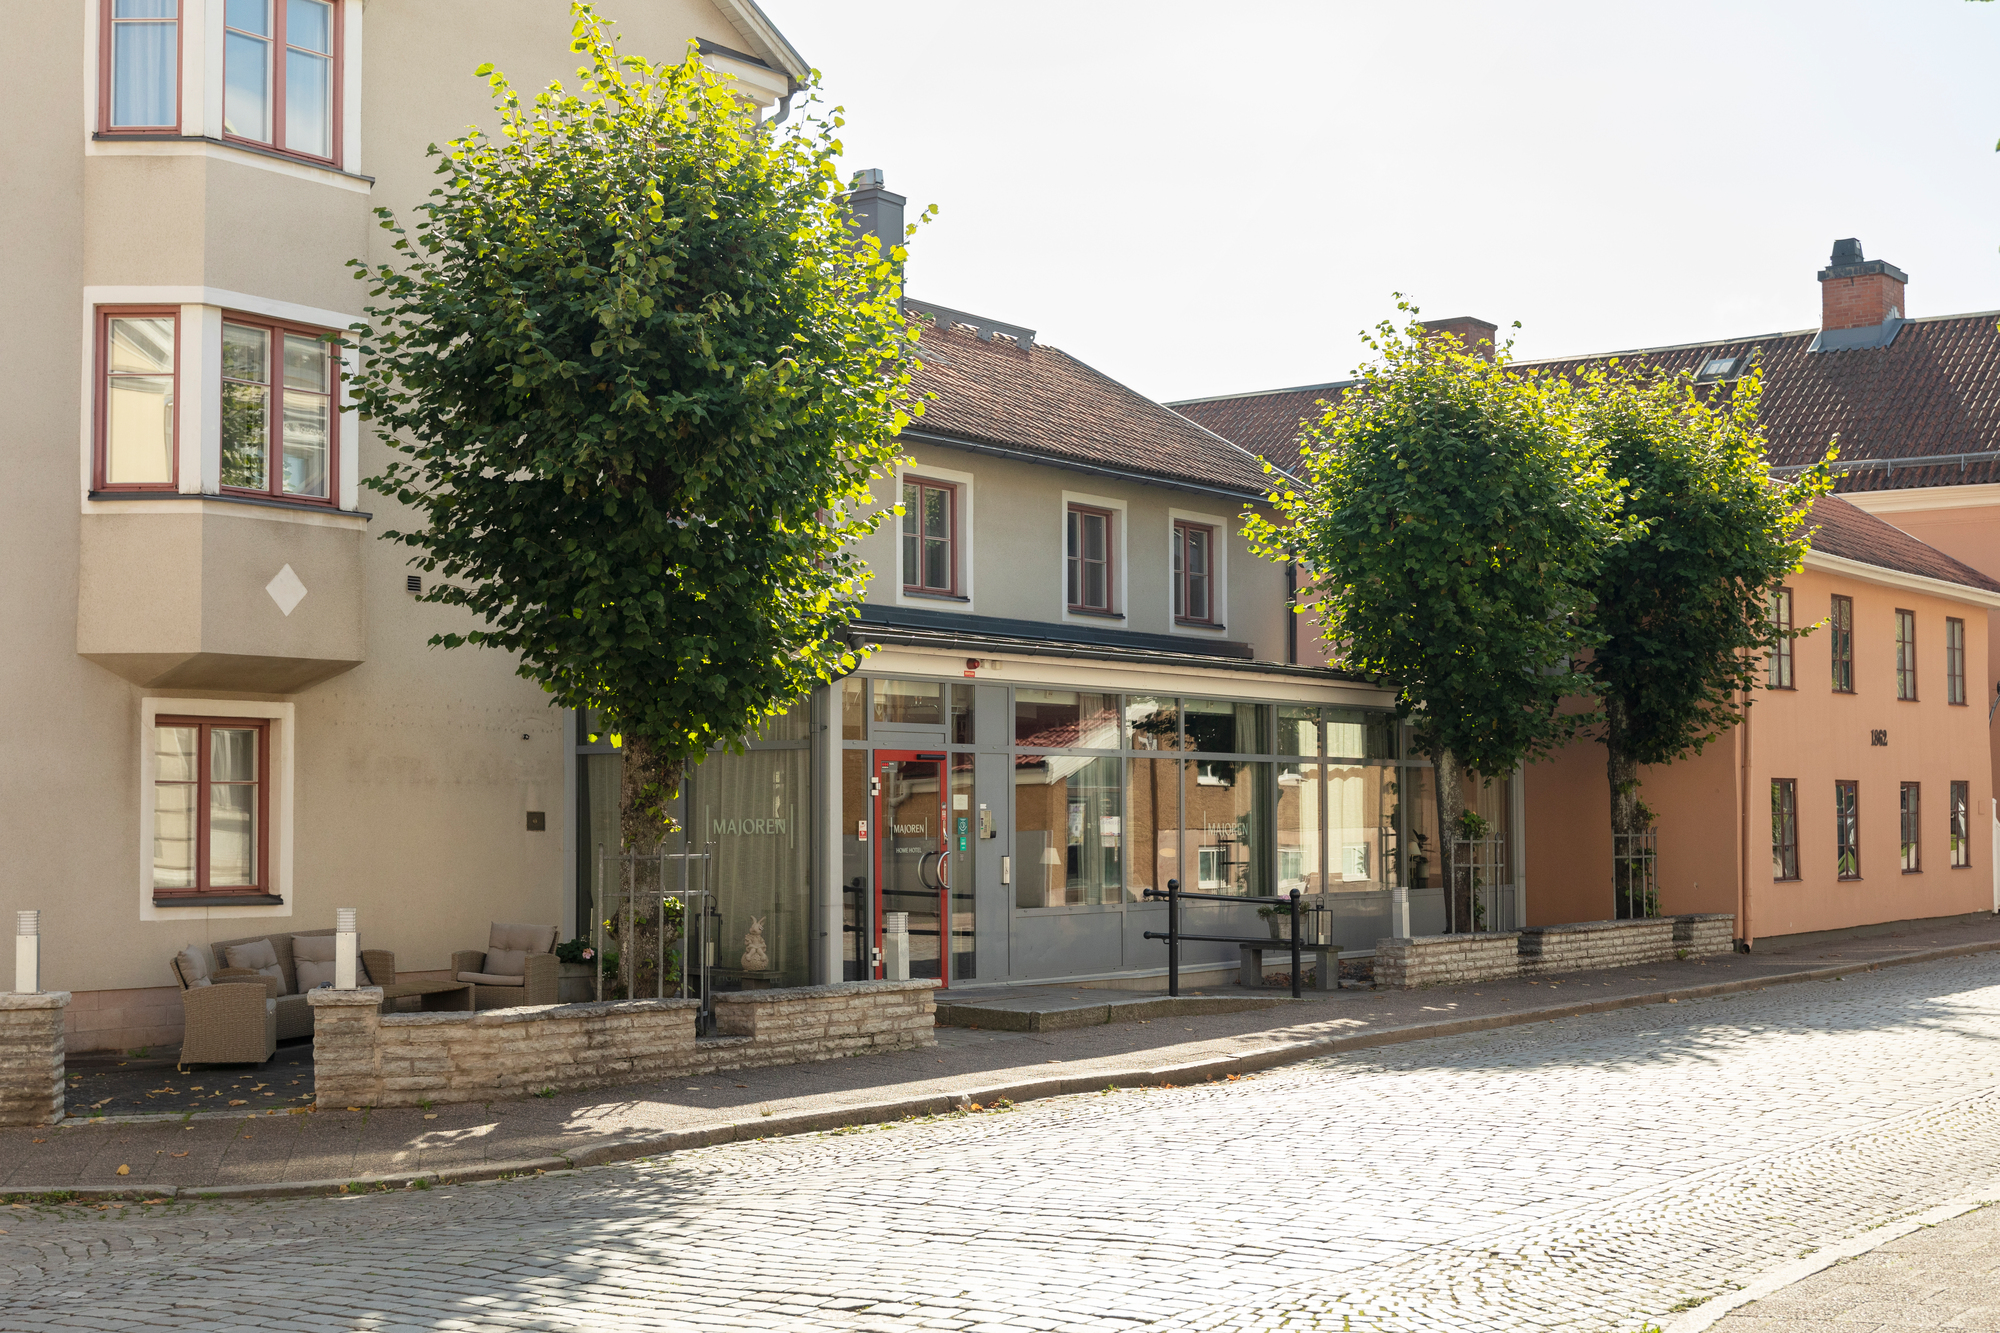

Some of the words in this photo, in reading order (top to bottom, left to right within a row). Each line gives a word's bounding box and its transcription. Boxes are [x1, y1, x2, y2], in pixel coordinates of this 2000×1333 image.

[1870, 729, 1888, 746] 1862
[713, 818, 786, 836] MAJOREN
[893, 824, 925, 834] MAJOREN
[1207, 822, 1249, 836] MAJOREN
